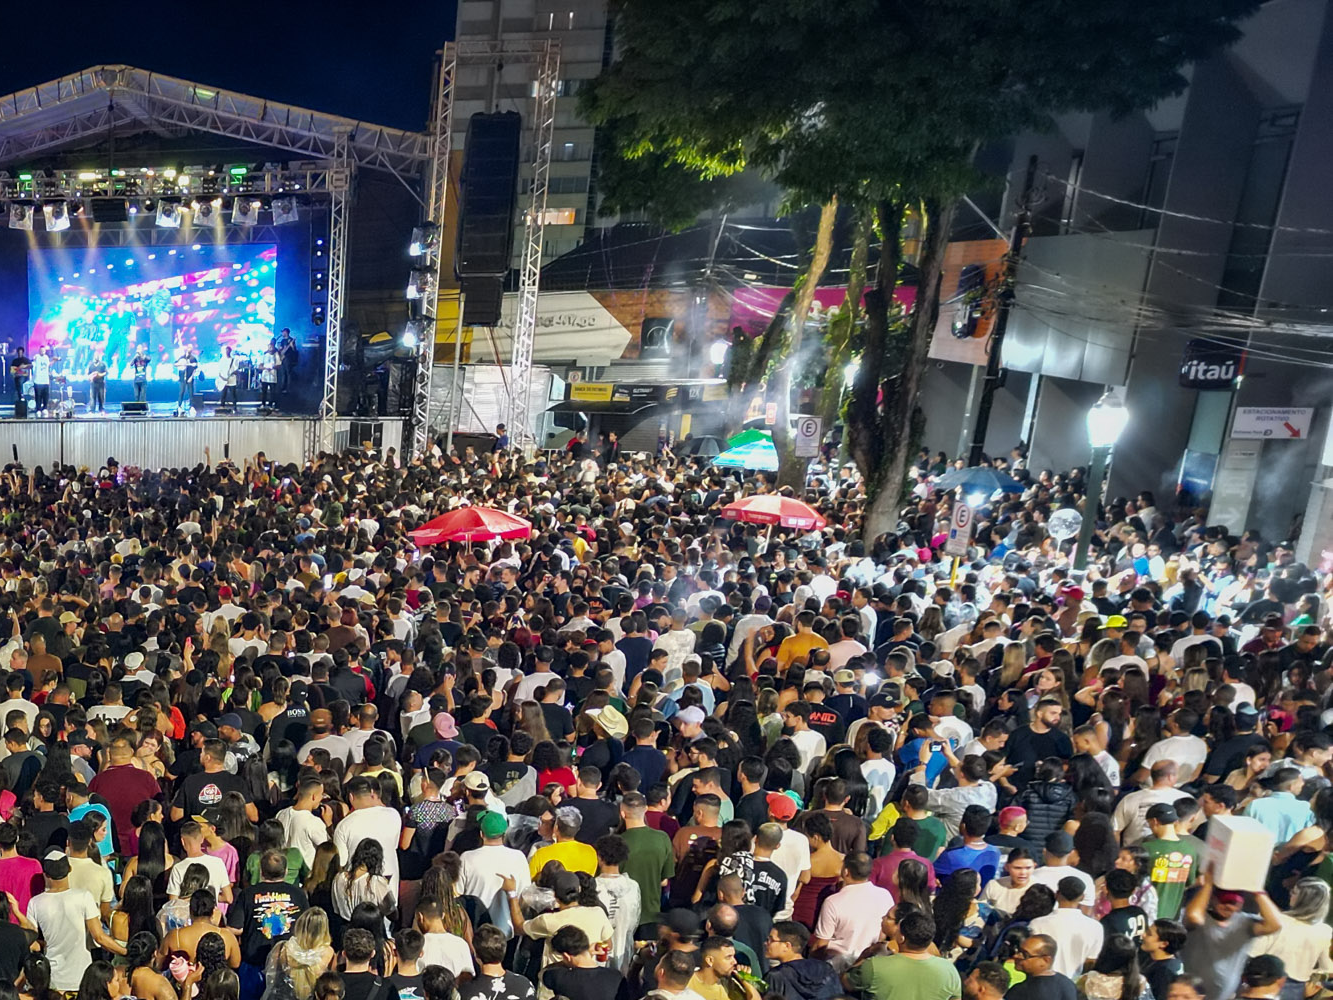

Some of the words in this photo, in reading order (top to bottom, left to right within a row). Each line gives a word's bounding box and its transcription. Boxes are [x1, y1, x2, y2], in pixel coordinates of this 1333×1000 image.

[1189, 360, 1235, 380] itaú
[806, 422, 813, 433] E
[959, 509, 967, 523] E
